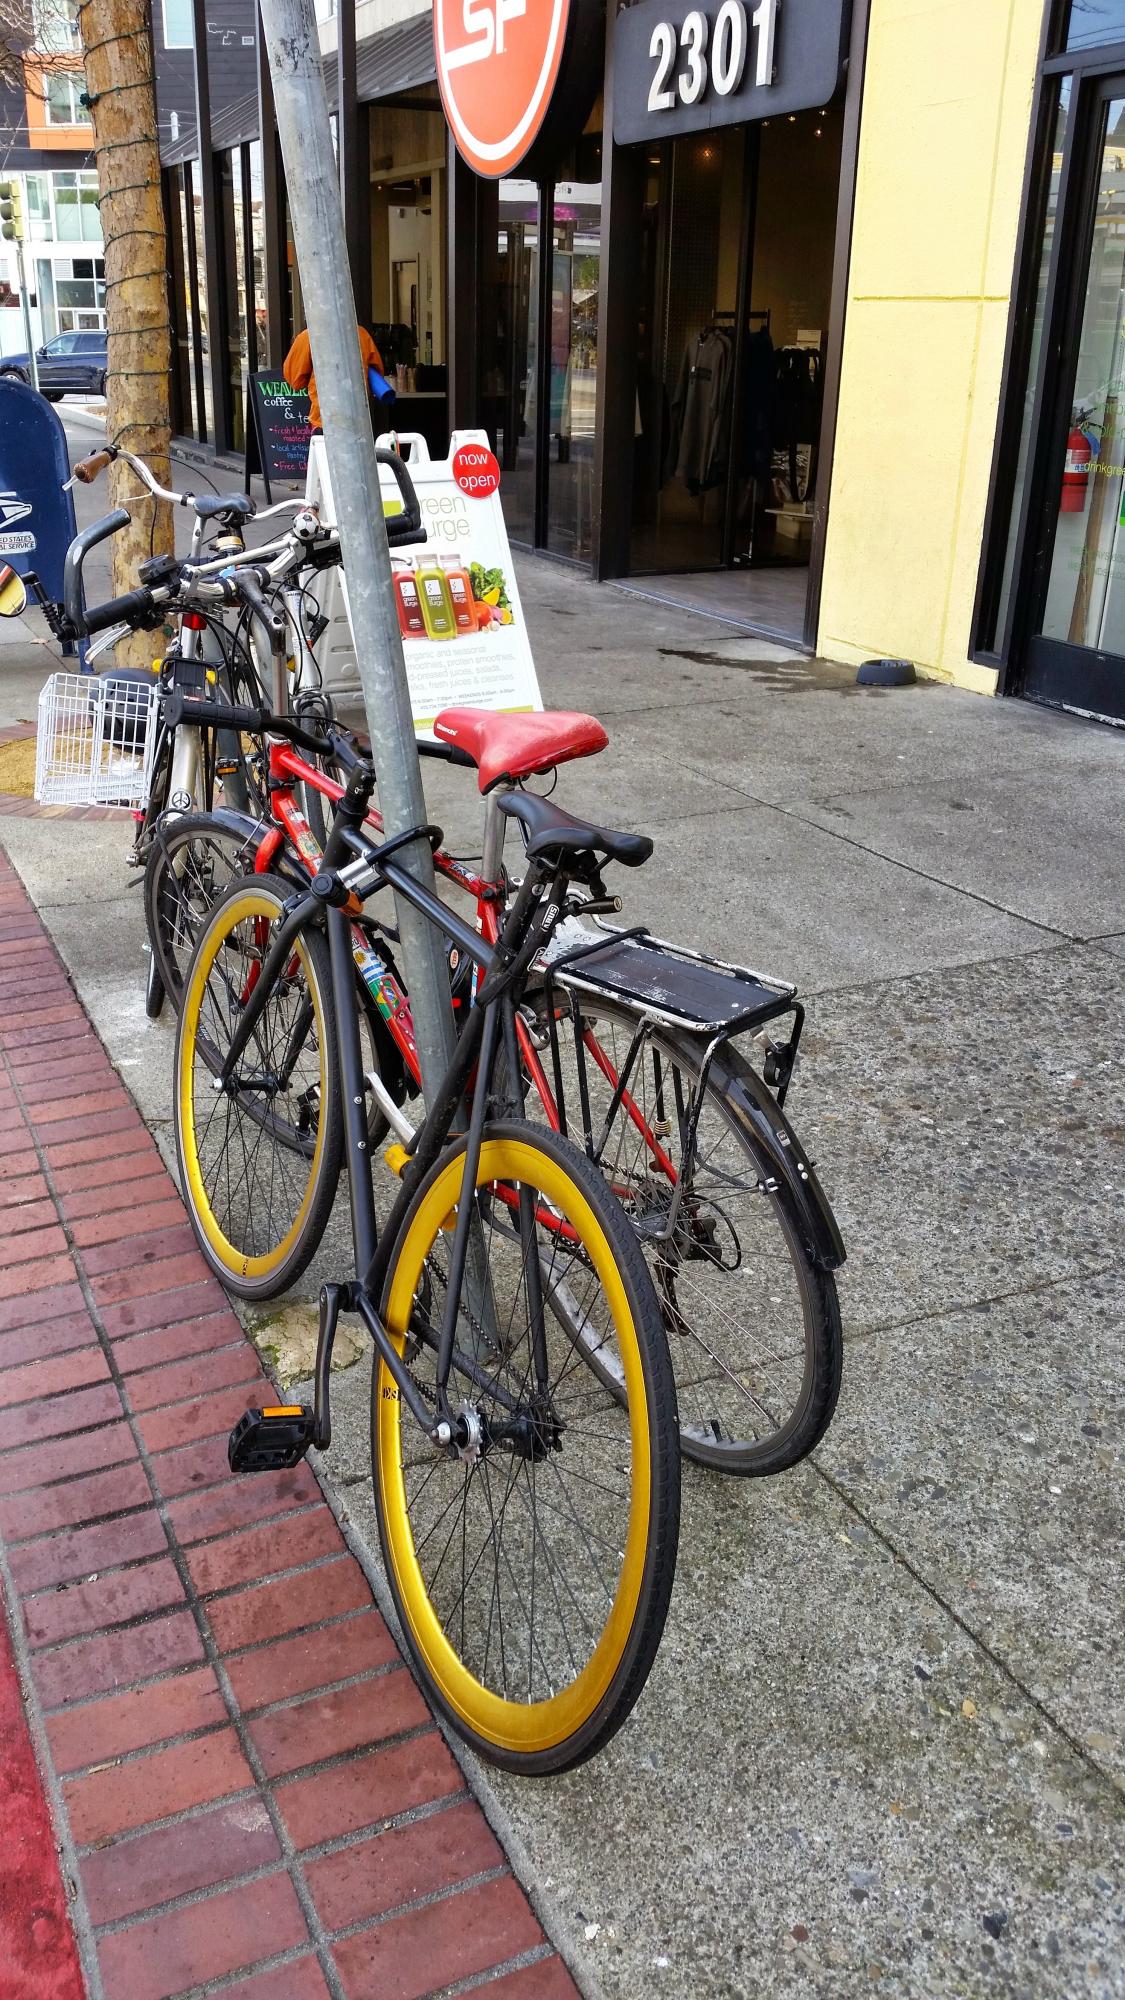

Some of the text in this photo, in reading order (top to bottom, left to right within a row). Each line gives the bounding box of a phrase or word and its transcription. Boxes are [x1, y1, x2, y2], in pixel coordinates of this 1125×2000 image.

[648, 0, 778, 112] 2301
[264, 397, 294, 407] coffee
[284, 407, 312, 424] & te
[459, 453, 488, 465] now
[279, 461, 296, 471] Free
[459, 475, 496, 491] open
[420, 496, 467, 515] reen
[422, 518, 470, 541] urge
[8, 542, 35, 550] SERVICE
[436, 649, 452, 658] and
[407, 660, 446, 671] moothies,
[408, 670, 448, 681] d-pressed
